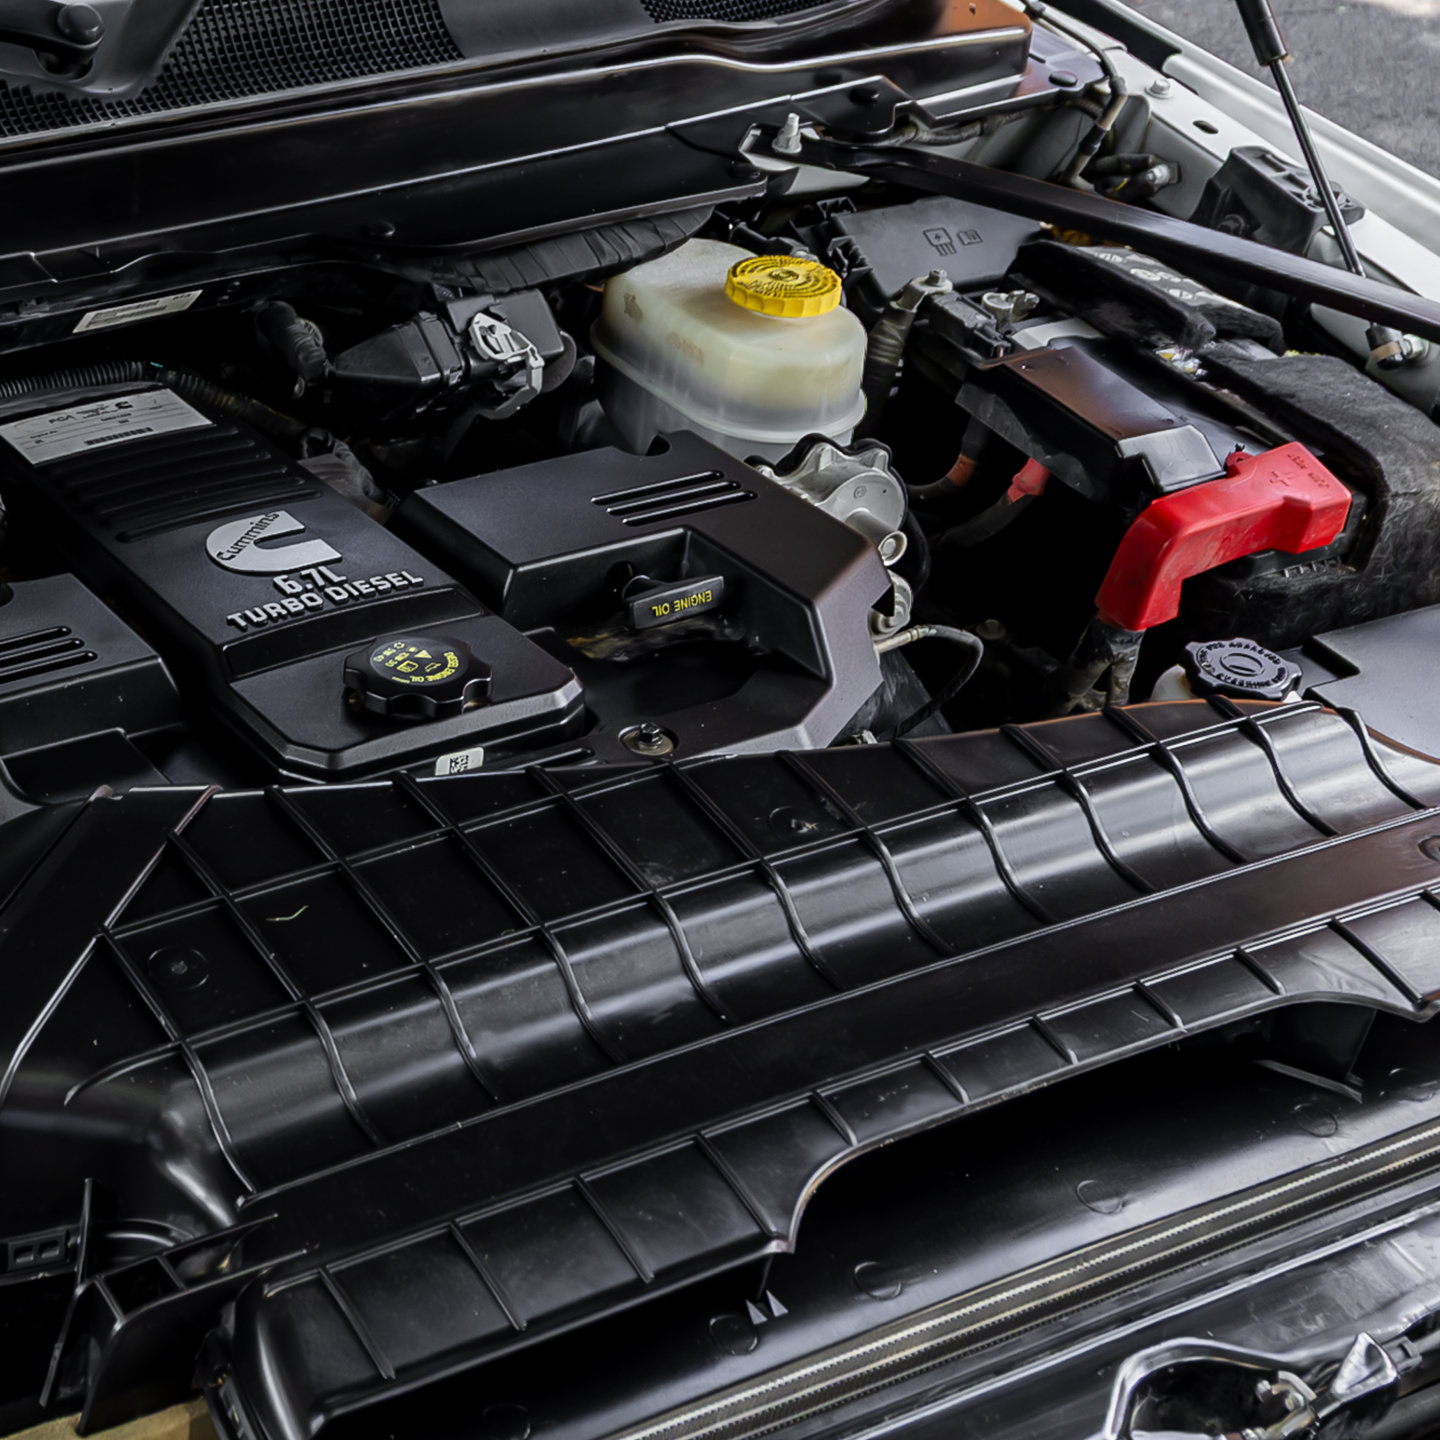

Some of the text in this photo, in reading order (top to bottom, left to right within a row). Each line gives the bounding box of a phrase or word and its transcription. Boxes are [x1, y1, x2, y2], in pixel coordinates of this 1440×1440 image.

[273, 565, 347, 596] 6.7L
[226, 571, 424, 630] TURBO DIESEL
[651, 590, 712, 617] ENGINE OIL
